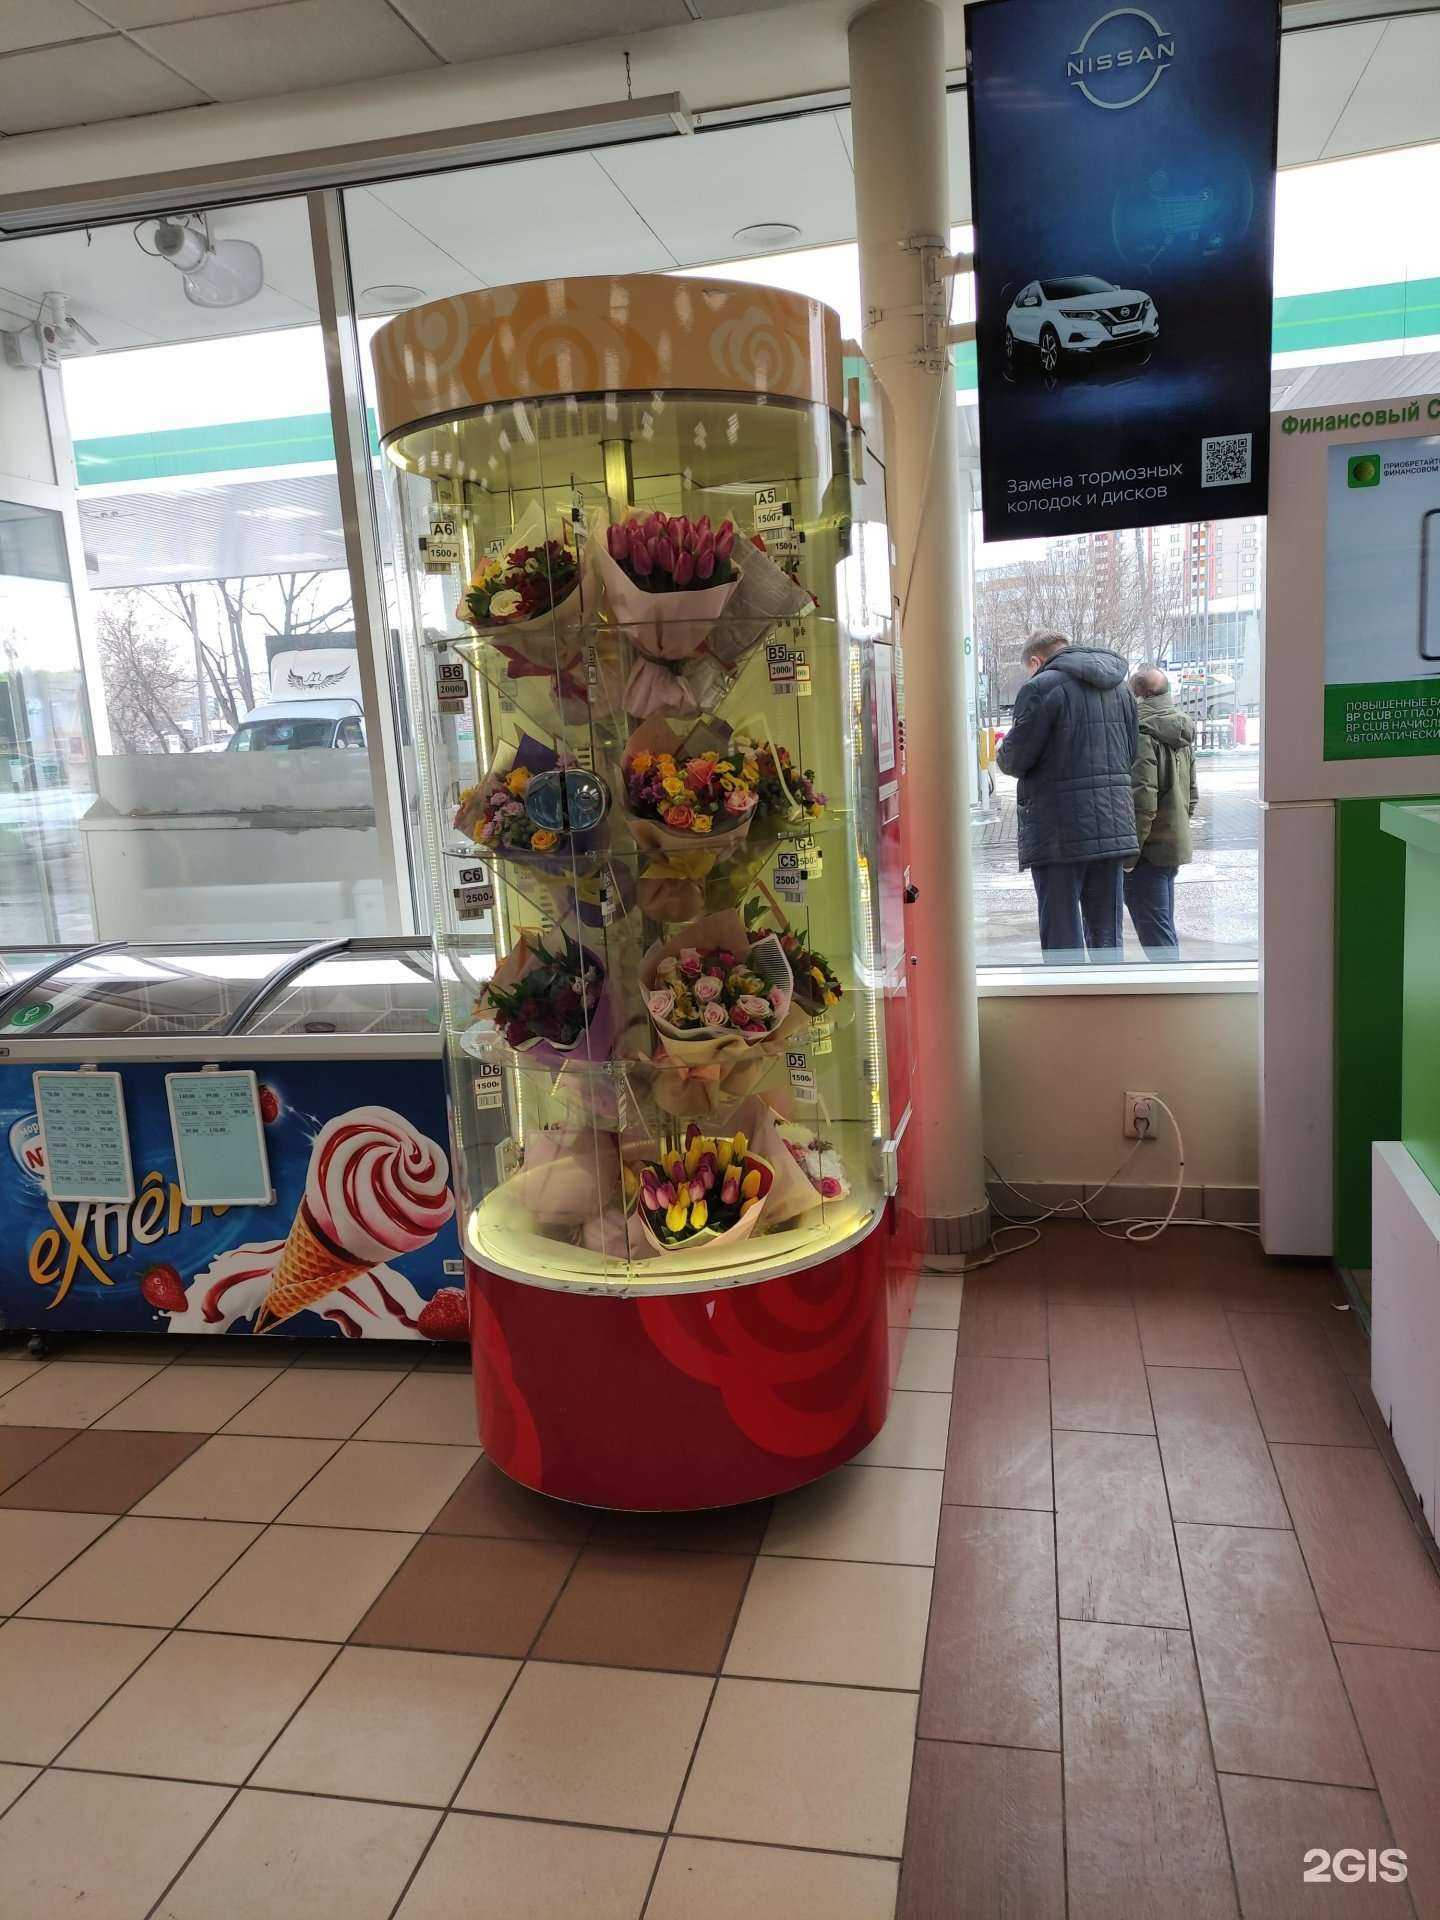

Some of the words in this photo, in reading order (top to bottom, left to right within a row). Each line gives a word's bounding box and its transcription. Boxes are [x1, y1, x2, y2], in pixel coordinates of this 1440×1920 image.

[1066, 40, 1175, 77] NISSAN
[1281, 401, 1420, 436] Финансовый
[1007, 475, 1074, 494] Замена
[1079, 463, 1183, 488] тормозных
[1383, 466, 1439, 477] ФИНАНСОВОМ
[758, 490, 775, 506] A5
[1007, 493, 1083, 513] колодок
[1086, 493, 1097, 505] и
[1101, 485, 1168, 507] дисков
[433, 523, 453, 536] A6
[768, 646, 785, 660] B5
[441, 664, 461, 678] B6
[1346, 697, 1428, 712] ПОВЫШЕННЫЕ
[1346, 712, 1361, 722] BP
[1363, 710, 1392, 721] CLUB
[1394, 709, 1409, 719] ОТ
[1411, 708, 1434, 718] ПАО
[1346, 723, 1361, 733] BP
[1362, 721, 1390, 731] CLUB
[1346, 729, 1440, 743] АВТОМАТИЧЕСКИ
[780, 855, 797, 868] C5
[462, 869, 481, 882] C6
[789, 1054, 804, 1067] D5
[482, 1064, 500, 1076] D6
